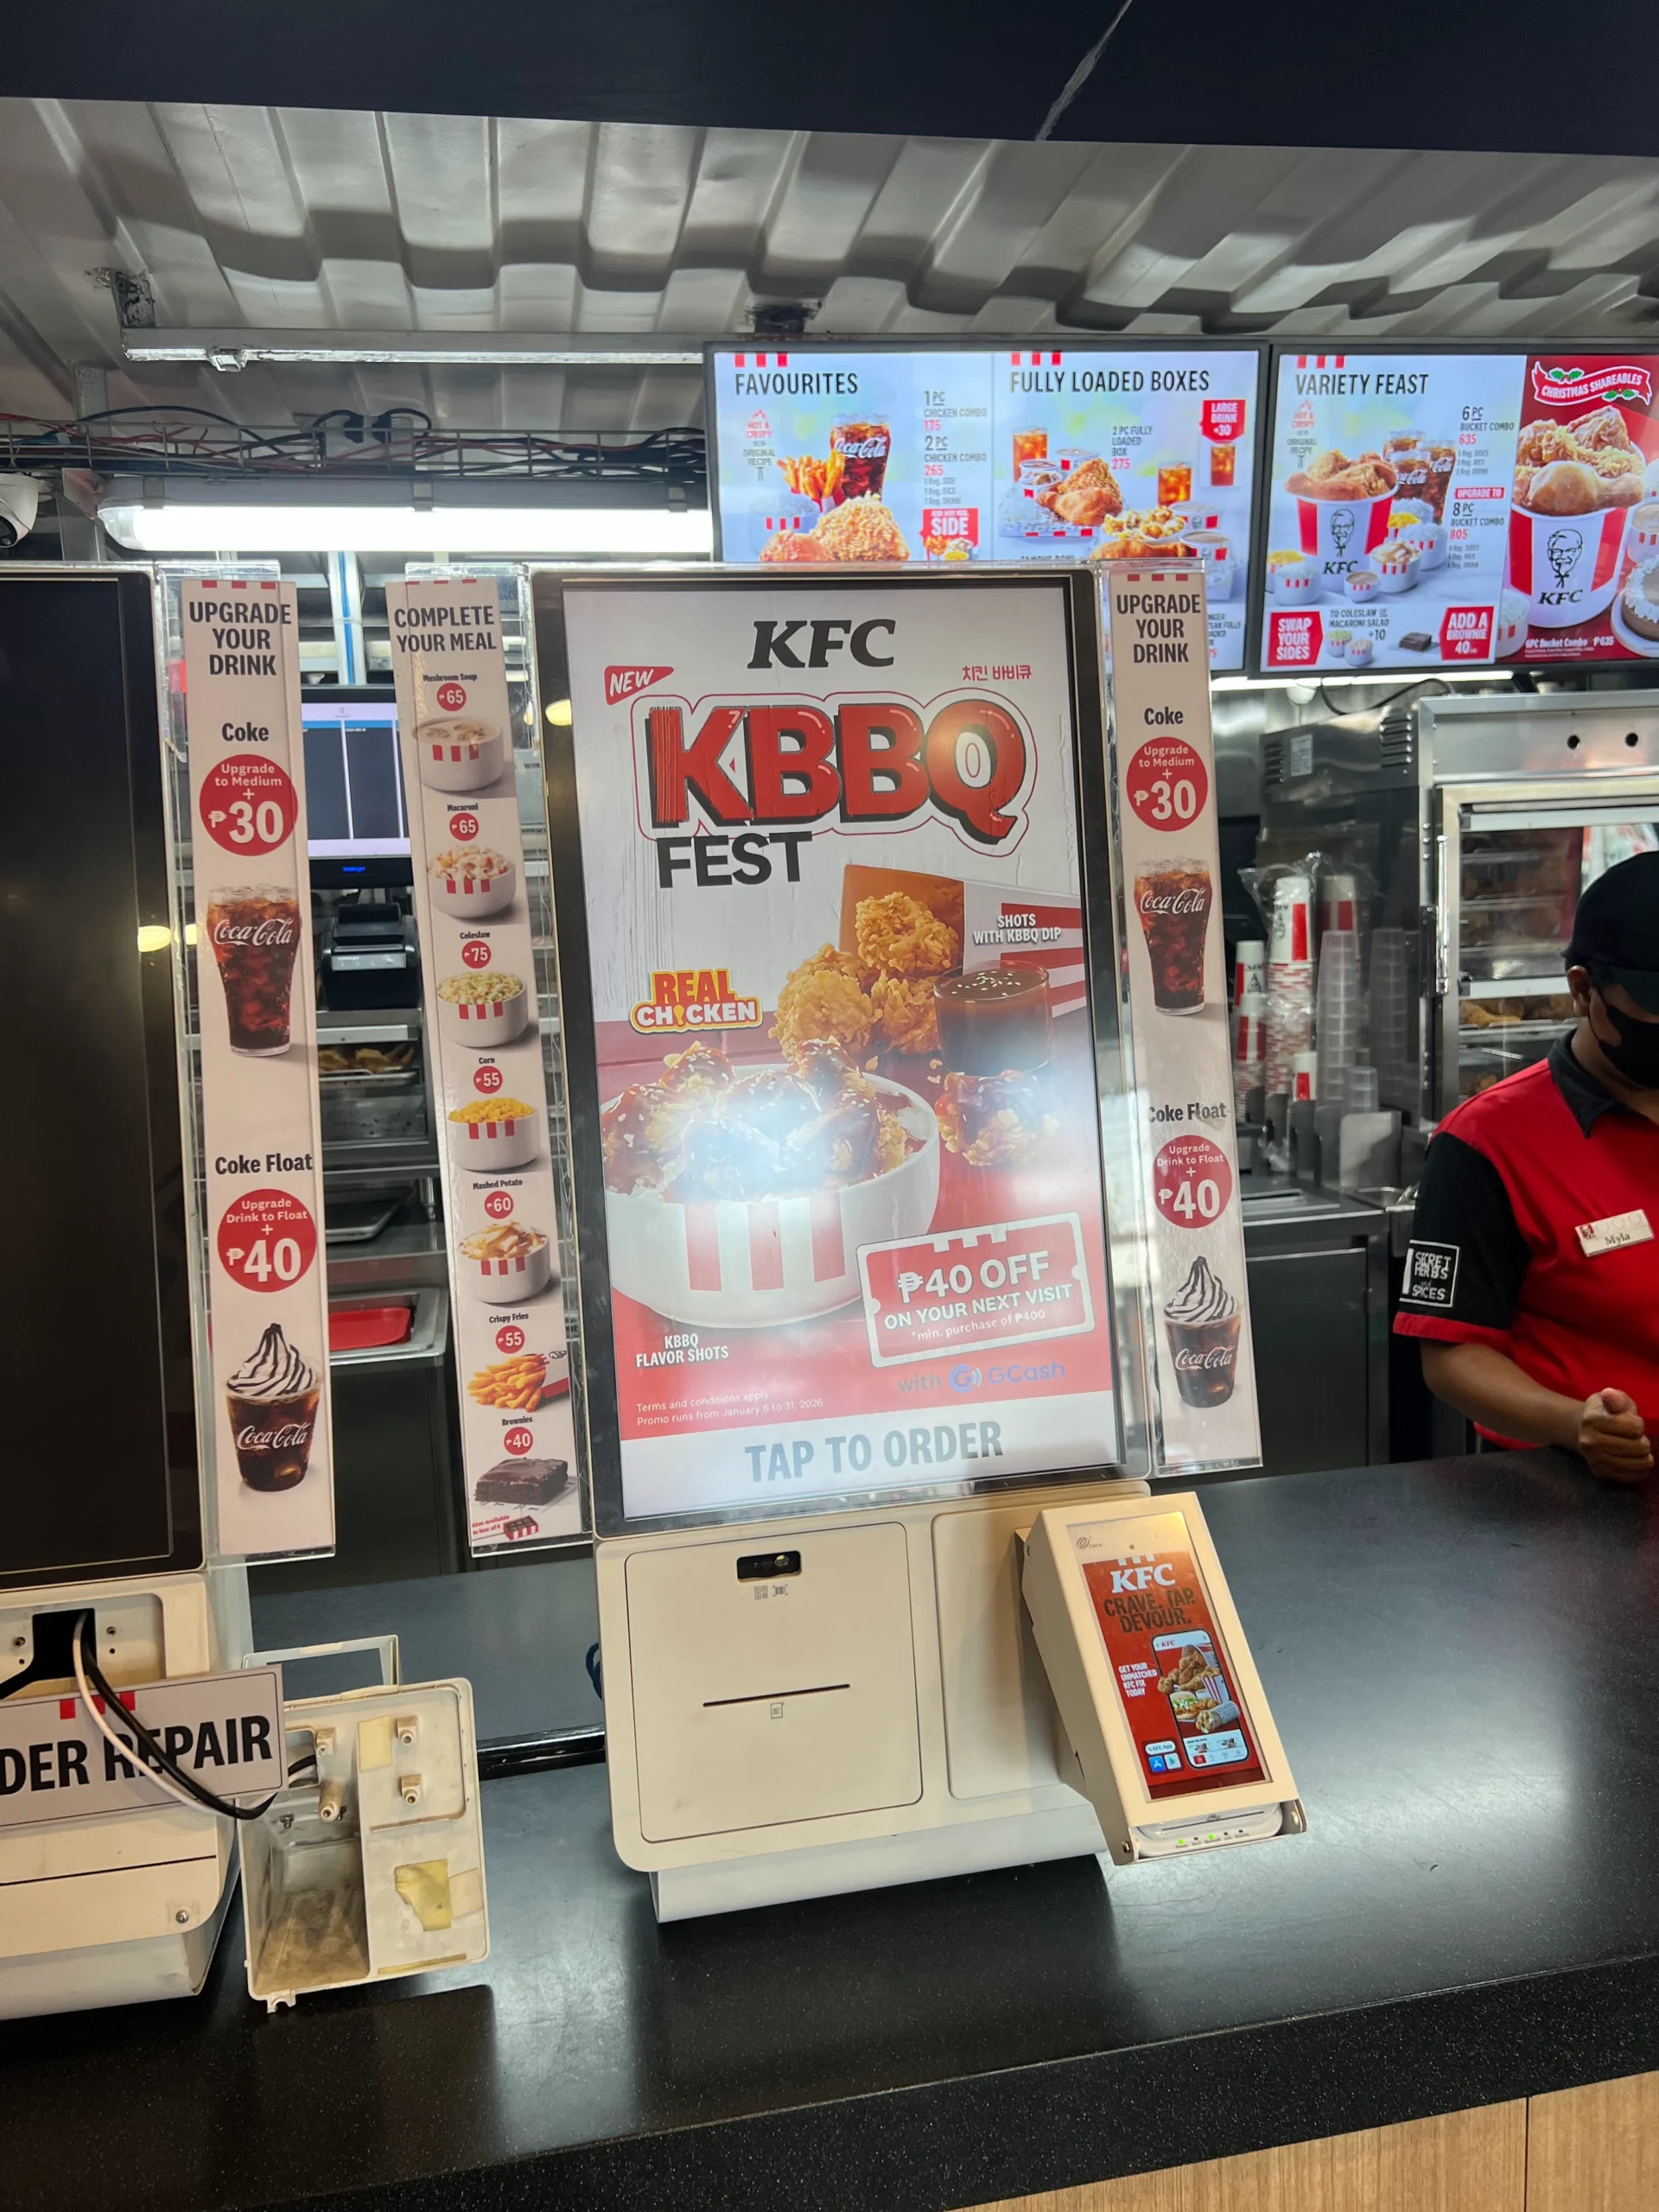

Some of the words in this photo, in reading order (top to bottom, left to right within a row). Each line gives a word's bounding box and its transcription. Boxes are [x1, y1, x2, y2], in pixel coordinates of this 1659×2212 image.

[735, 373, 858, 395] FAVOURITES
[1010, 372, 1065, 392] FULLY
[1072, 372, 1143, 391] LOADED
[1151, 371, 1209, 391] BOXES
[1296, 374, 1370, 394] VARIETY
[1376, 374, 1428, 394] FEAST
[1541, 383, 1590, 398] CHRISTMAS
[1590, 373, 1643, 392] SHAREABLES
[1211, 403, 1237, 413] LARGE
[1462, 406, 1470, 421] 6
[1472, 407, 1484, 417] PC
[924, 420, 941, 431] 175
[1460, 423, 1488, 431] BUCKET
[925, 436, 933, 451] 2
[1459, 435, 1477, 445] 635
[925, 465, 944, 475] 265
[1112, 459, 1129, 469] 275
[1458, 488, 1491, 498] UPGRADE
[1492, 488, 1502, 497] TO
[1453, 503, 1460, 517] 8
[1462, 504, 1473, 512] PC
[931, 518, 969, 536] SIDE
[1450, 530, 1467, 539] 805
[1323, 561, 1357, 574] KFC
[1117, 594, 1201, 614] UPGRADE
[1539, 589, 1583, 605] KFC
[189, 602, 291, 625] UPGRADE
[394, 606, 494, 628] COMPLETE
[1448, 613, 1476, 628] ADD
[1478, 613, 1488, 626] A
[1136, 619, 1184, 639] YOUR
[1278, 619, 1313, 632] SWAP
[213, 628, 271, 650] YOUR
[397, 634, 446, 652] YOUR
[449, 632, 497, 651] MEAL
[1278, 632, 1310, 646] YOUR
[1369, 630, 1385, 640] +10
[1446, 629, 1486, 639] BROWNIE
[747, 618, 897, 670] KFC
[1455, 641, 1470, 654] 40
[1134, 643, 1189, 664] DRINK
[1276, 646, 1310, 660] SIDES
[209, 655, 276, 676] DRINK
[962, 665, 988, 681] 치킨
[992, 664, 1032, 680] 바비큐
[423, 674, 459, 683] Mushroom
[461, 673, 478, 682] Soup
[608, 668, 655, 698] NEW
[1144, 707, 1184, 725] Coke
[222, 722, 269, 741] Coke
[1144, 745, 1188, 756] Upgrade
[1153, 757, 1195, 766] Medium
[221, 764, 275, 776] Upgrade
[645, 699, 1027, 846] KBBQ
[215, 778, 228, 786] to
[232, 776, 282, 786] Medium
[447, 803, 479, 811] Macaroni
[656, 831, 813, 889] FEST
[1140, 887, 1206, 914] Coca-Cola
[997, 913, 1036, 928] SHOTS
[213, 917, 295, 946] Coca-Cola
[973, 930, 1004, 944] WITH
[1007, 929, 1039, 944] KBBQ
[1042, 927, 1061, 941] DIP
[654, 971, 735, 1006] REAL
[1149, 1105, 1183, 1123] Coke
[1187, 1103, 1227, 1120] Float
[1169, 1143, 1210, 1155] Upgrade
[215, 1155, 261, 1174] Coke
[266, 1153, 314, 1173] Float
[1157, 1157, 1184, 1166] Drink
[1198, 1154, 1224, 1163] Float
[473, 1180, 499, 1190] Mashed
[500, 1179, 523, 1187] Potato
[242, 1198, 291, 1211] Upgrade
[226, 1213, 259, 1223] Drink
[262, 1213, 275, 1222] to
[277, 1211, 308, 1220] Float
[1605, 1232, 1630, 1246] Myla
[980, 1250, 1050, 1289] OFF
[884, 1312, 912, 1330] ON
[916, 1302, 968, 1325] YOUR
[972, 1293, 1020, 1314] NEXT
[1025, 1283, 1072, 1304] VISIT
[945, 1318, 998, 1338] purchase
[1001, 1313, 1014, 1325] of
[664, 1333, 699, 1349] KBBQ
[636, 1350, 684, 1368] FLAVOR
[688, 1345, 729, 1362] SHOTS
[1174, 1345, 1234, 1370] Coca-Cola
[898, 1373, 942, 1393] with
[988, 1361, 1065, 1384] GCash
[637, 1403, 666, 1413] Terms
[669, 1399, 688, 1409] and
[690, 1393, 741, 1407] conditions
[638, 1416, 670, 1426] Promo
[672, 1412, 694, 1421] runs
[696, 1408, 719, 1420] from
[721, 1406, 760, 1418] January
[762, 1404, 769, 1413] 6
[772, 1402, 782, 1411] to
[785, 1401, 798, 1411] 31,
[799, 1398, 823, 1409] 2026
[502, 1416, 533, 1426] Brownies
[237, 1422, 311, 1450] Coca-Cola
[745, 1440, 815, 1483] TAP
[824, 1433, 872, 1474] TO
[883, 1421, 1004, 1468] ORDER
[486, 1515, 510, 1524] available
[1110, 1563, 1176, 1594] KFC
[1103, 1593, 1164, 1618] CRAVE.
[1165, 1588, 1196, 1607] TAP.
[1120, 1607, 1192, 1633] DEVOUR.
[1119, 1665, 1130, 1674] GET
[1131, 1662, 1148, 1671] YOUR
[1121, 1669, 1157, 1681] UNMATCHED
[1123, 1681, 1135, 1689] KFC
[1135, 1679, 1146, 1688] FIX
[1125, 1688, 1145, 1698] TODAY
[103, 1715, 273, 1782] REPAIR
